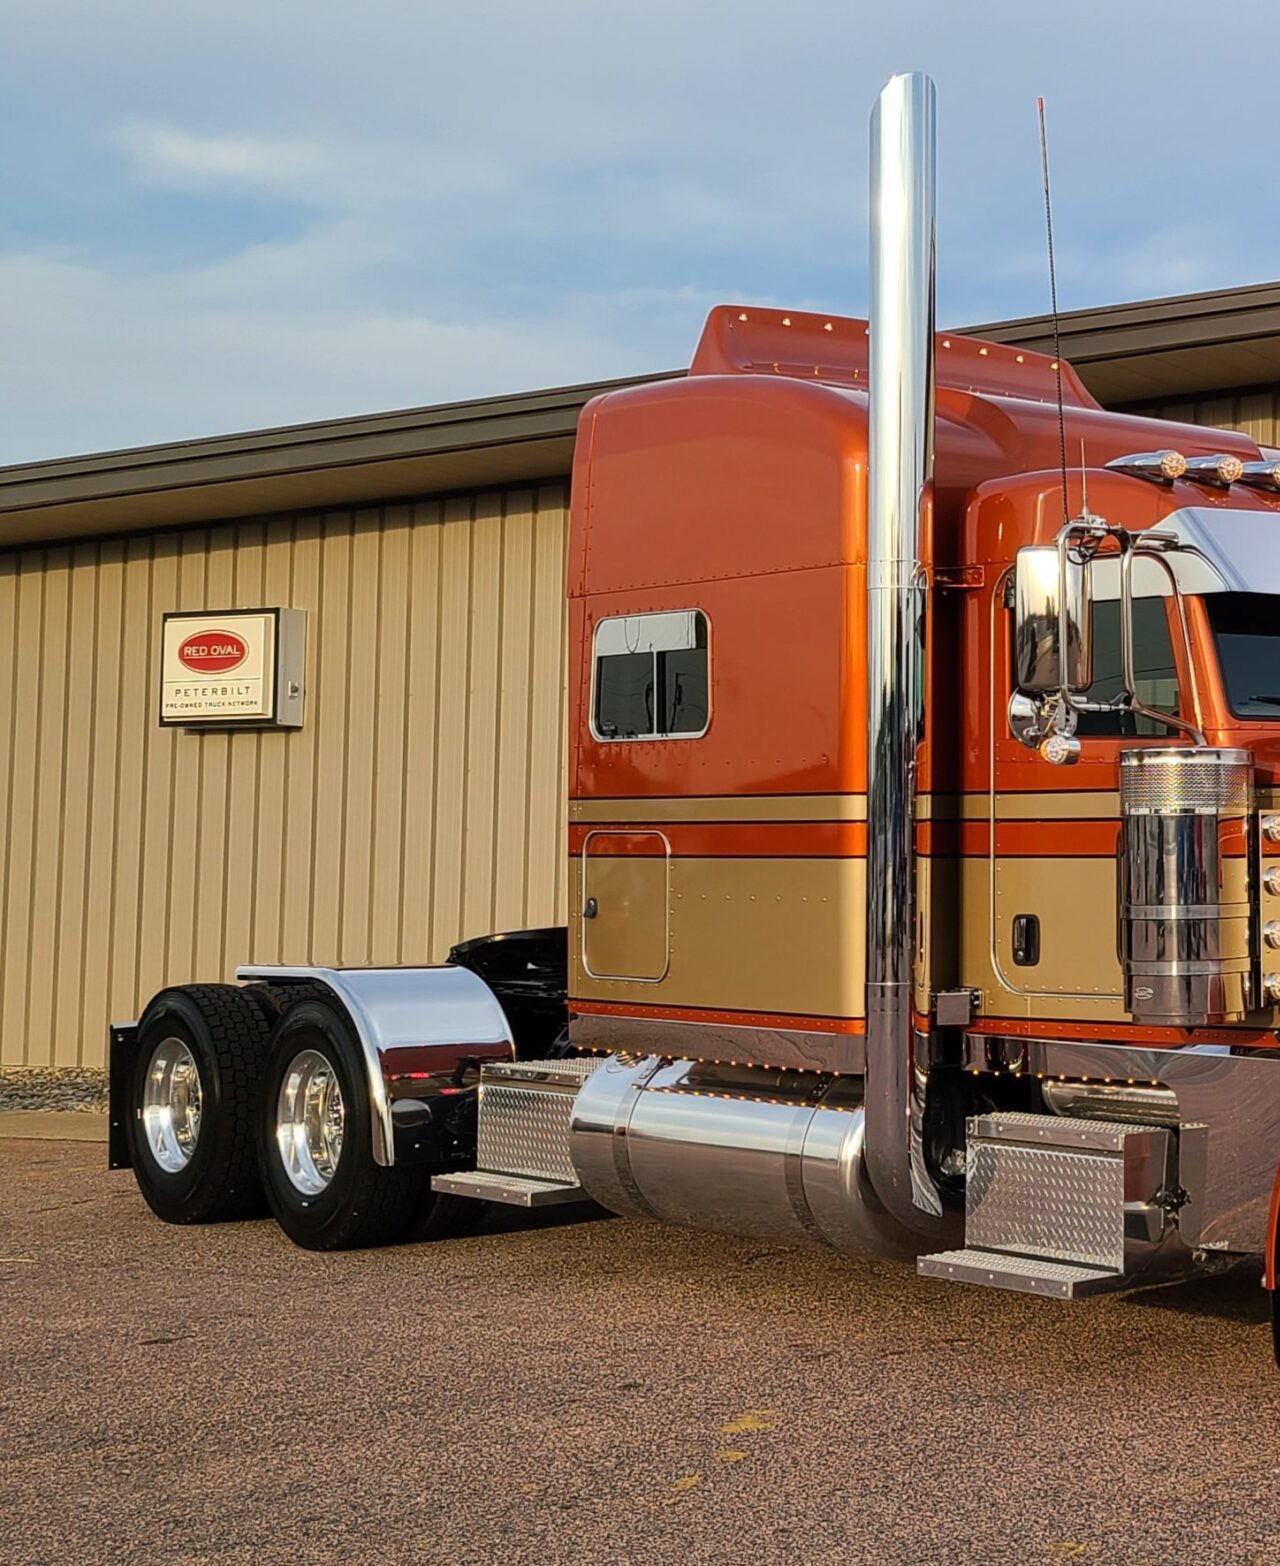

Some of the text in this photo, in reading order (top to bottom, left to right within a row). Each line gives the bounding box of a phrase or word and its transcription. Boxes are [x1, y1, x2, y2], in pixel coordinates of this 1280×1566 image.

[184, 645, 241, 656] RED OVAL
[175, 686, 250, 697] PETERBILT
